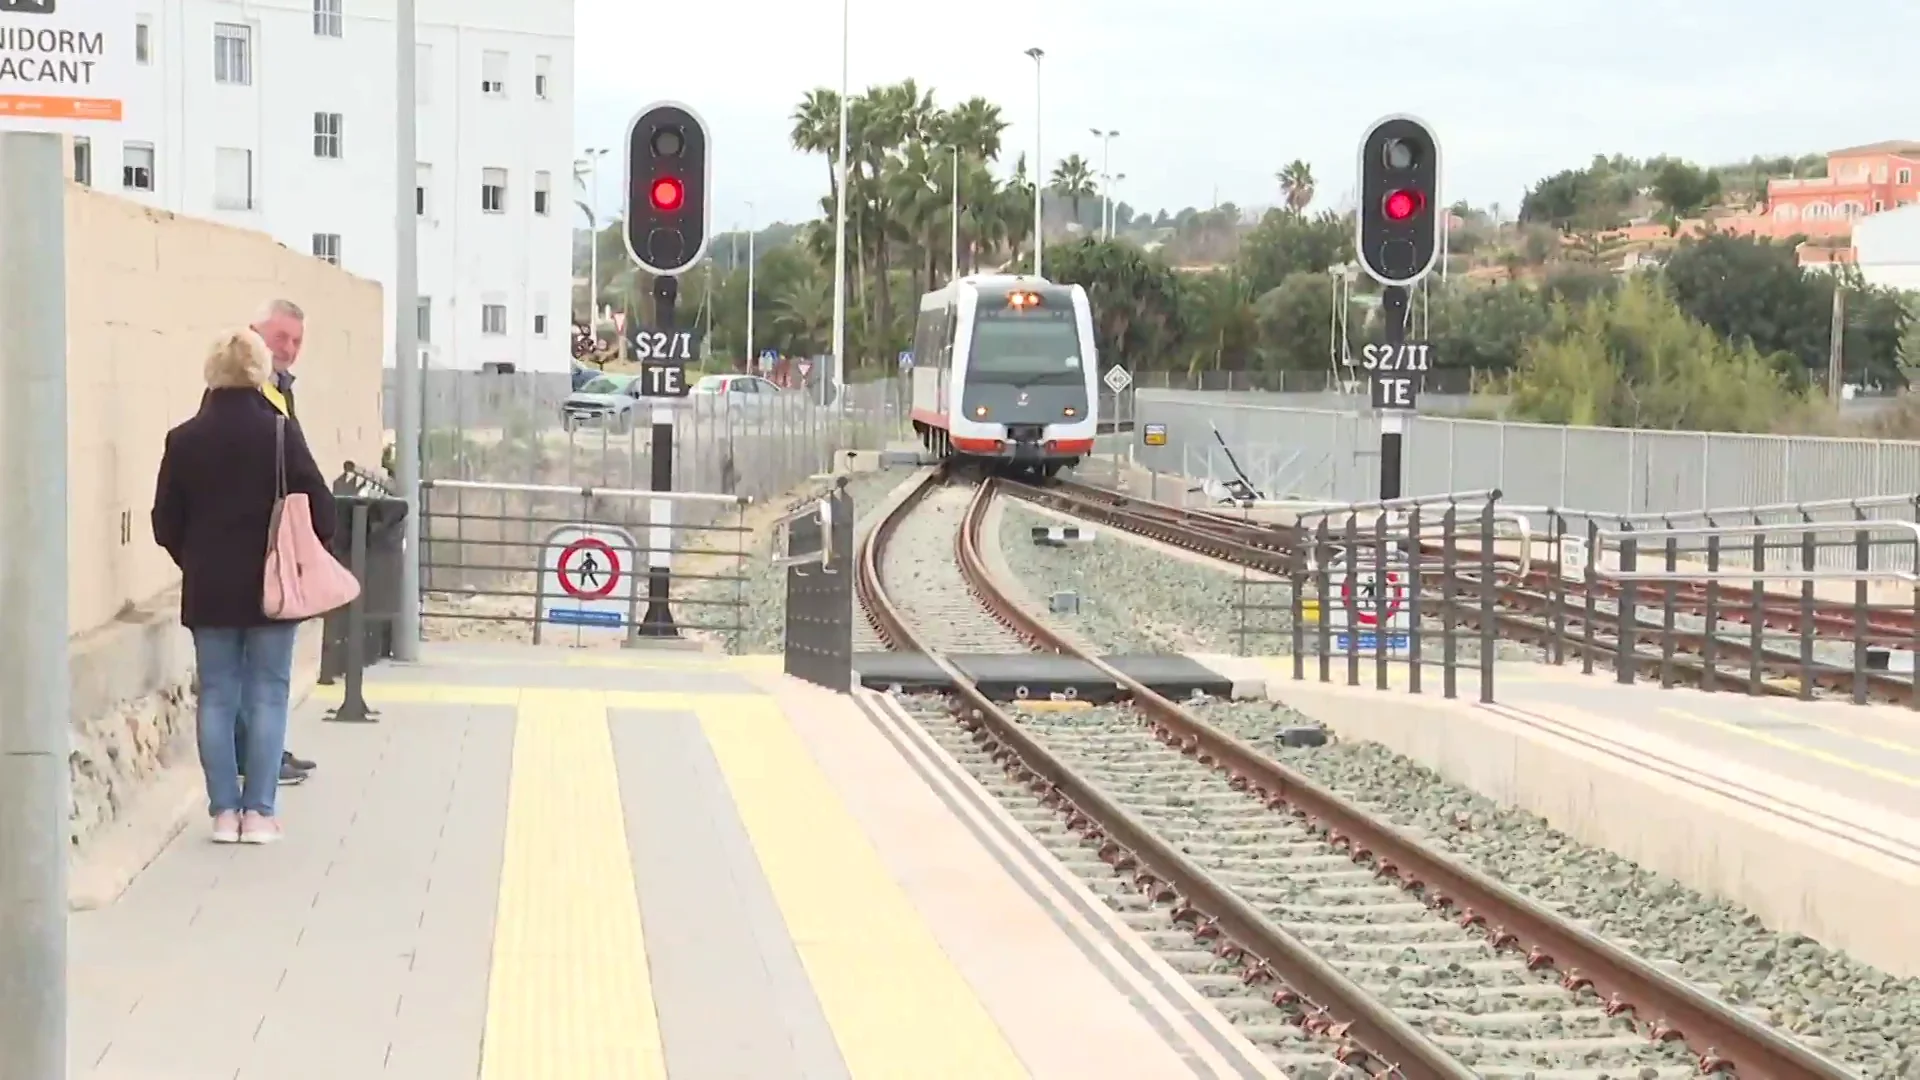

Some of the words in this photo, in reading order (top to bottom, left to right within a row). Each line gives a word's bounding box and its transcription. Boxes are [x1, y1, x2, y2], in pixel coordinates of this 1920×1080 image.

[0, 26, 104, 55] IDORM
[0, 57, 97, 85] ACANT
[635, 331, 692, 359] S2/I
[1362, 343, 1429, 370] S2/II
[648, 366, 681, 393] TE
[1379, 378, 1411, 404] TE
